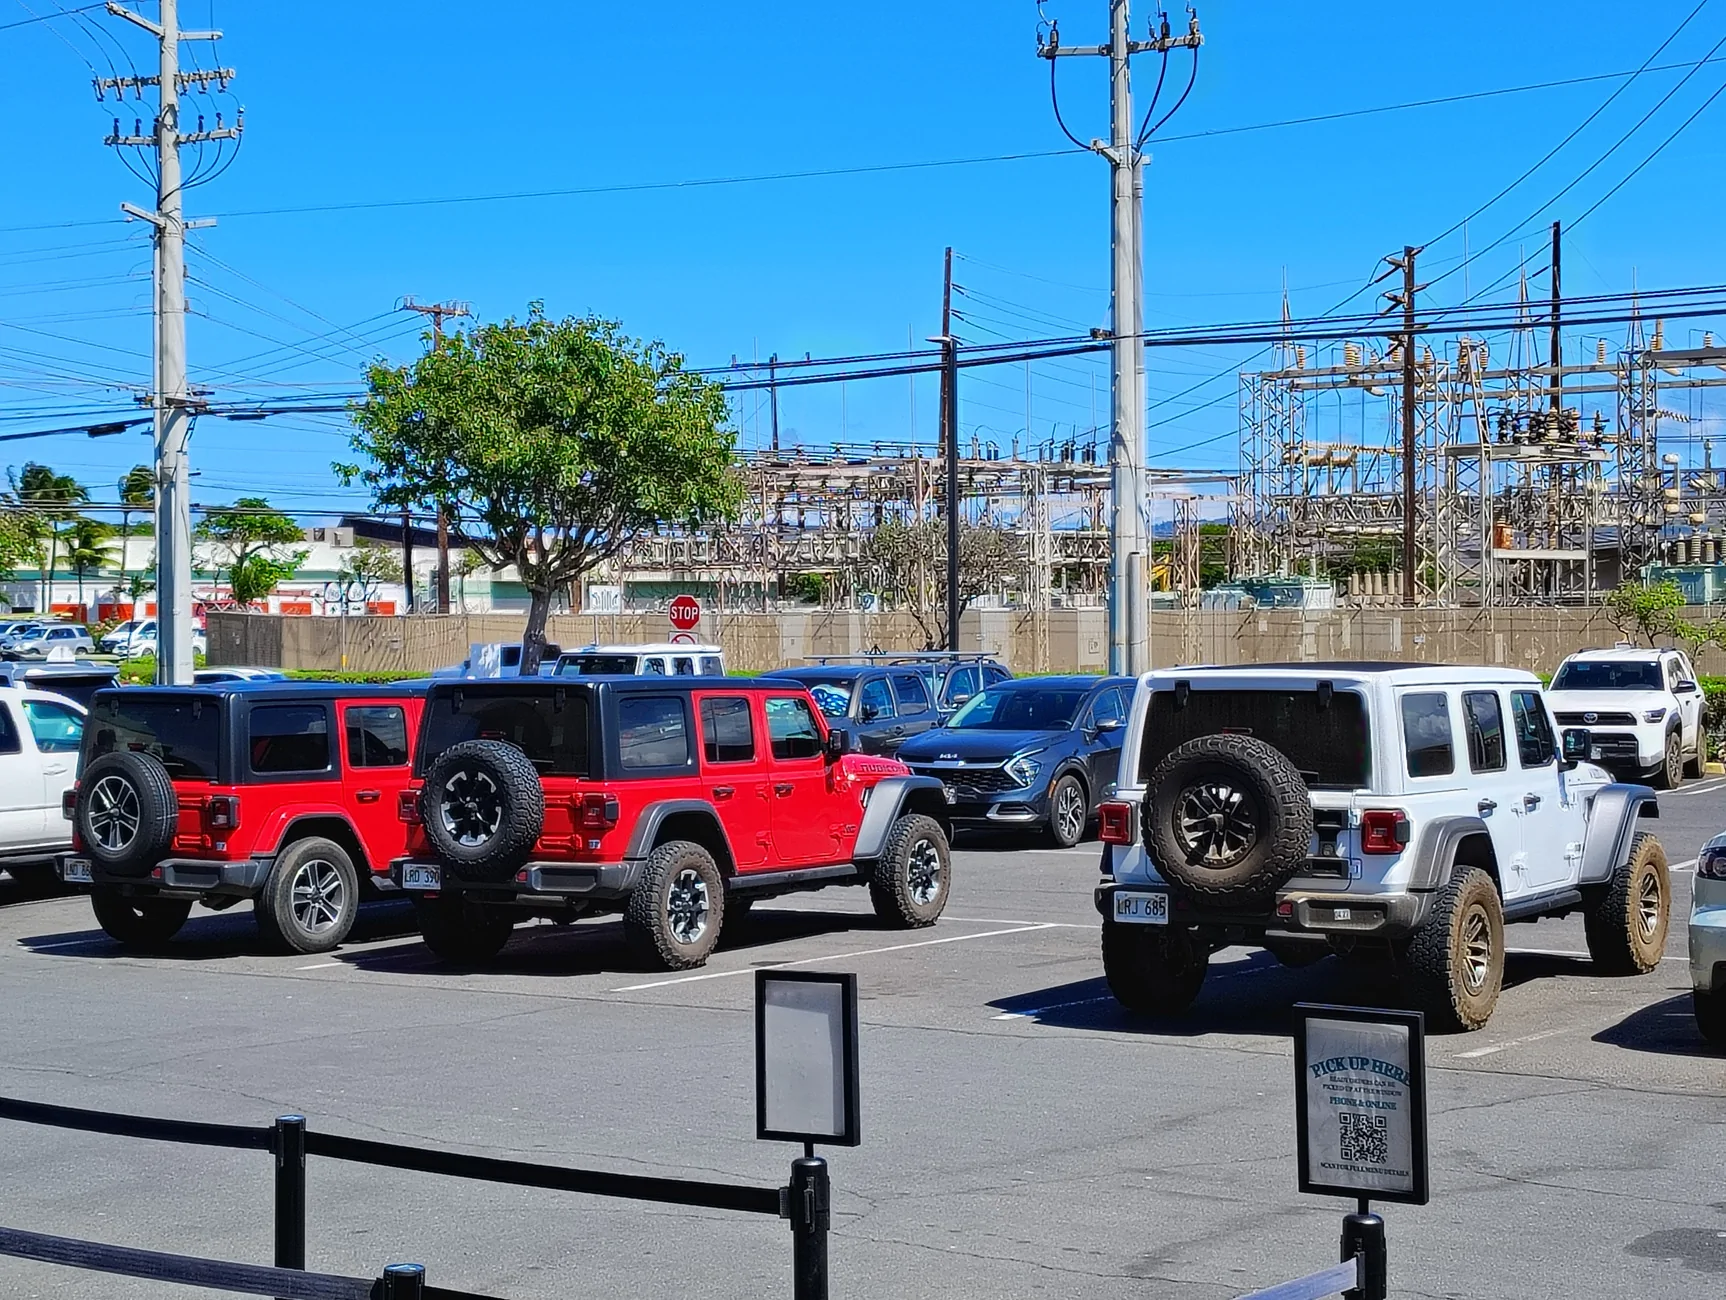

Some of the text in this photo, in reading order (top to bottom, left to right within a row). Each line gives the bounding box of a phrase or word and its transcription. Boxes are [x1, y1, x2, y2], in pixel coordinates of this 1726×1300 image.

[671, 606, 698, 620] STOP
[860, 764, 906, 773] RUBICON
[404, 869, 440, 884] LRD 390
[1117, 897, 1166, 916] LRJ 685
[1309, 1057, 1348, 1078] PICK
[1347, 1056, 1370, 1071] UP
[1322, 1083, 1345, 1092] PICKED
[1329, 1096, 1357, 1107] PHONE
[1365, 1100, 1397, 1110] ONLINE
[1384, 1168, 1409, 1177] DETAILS
